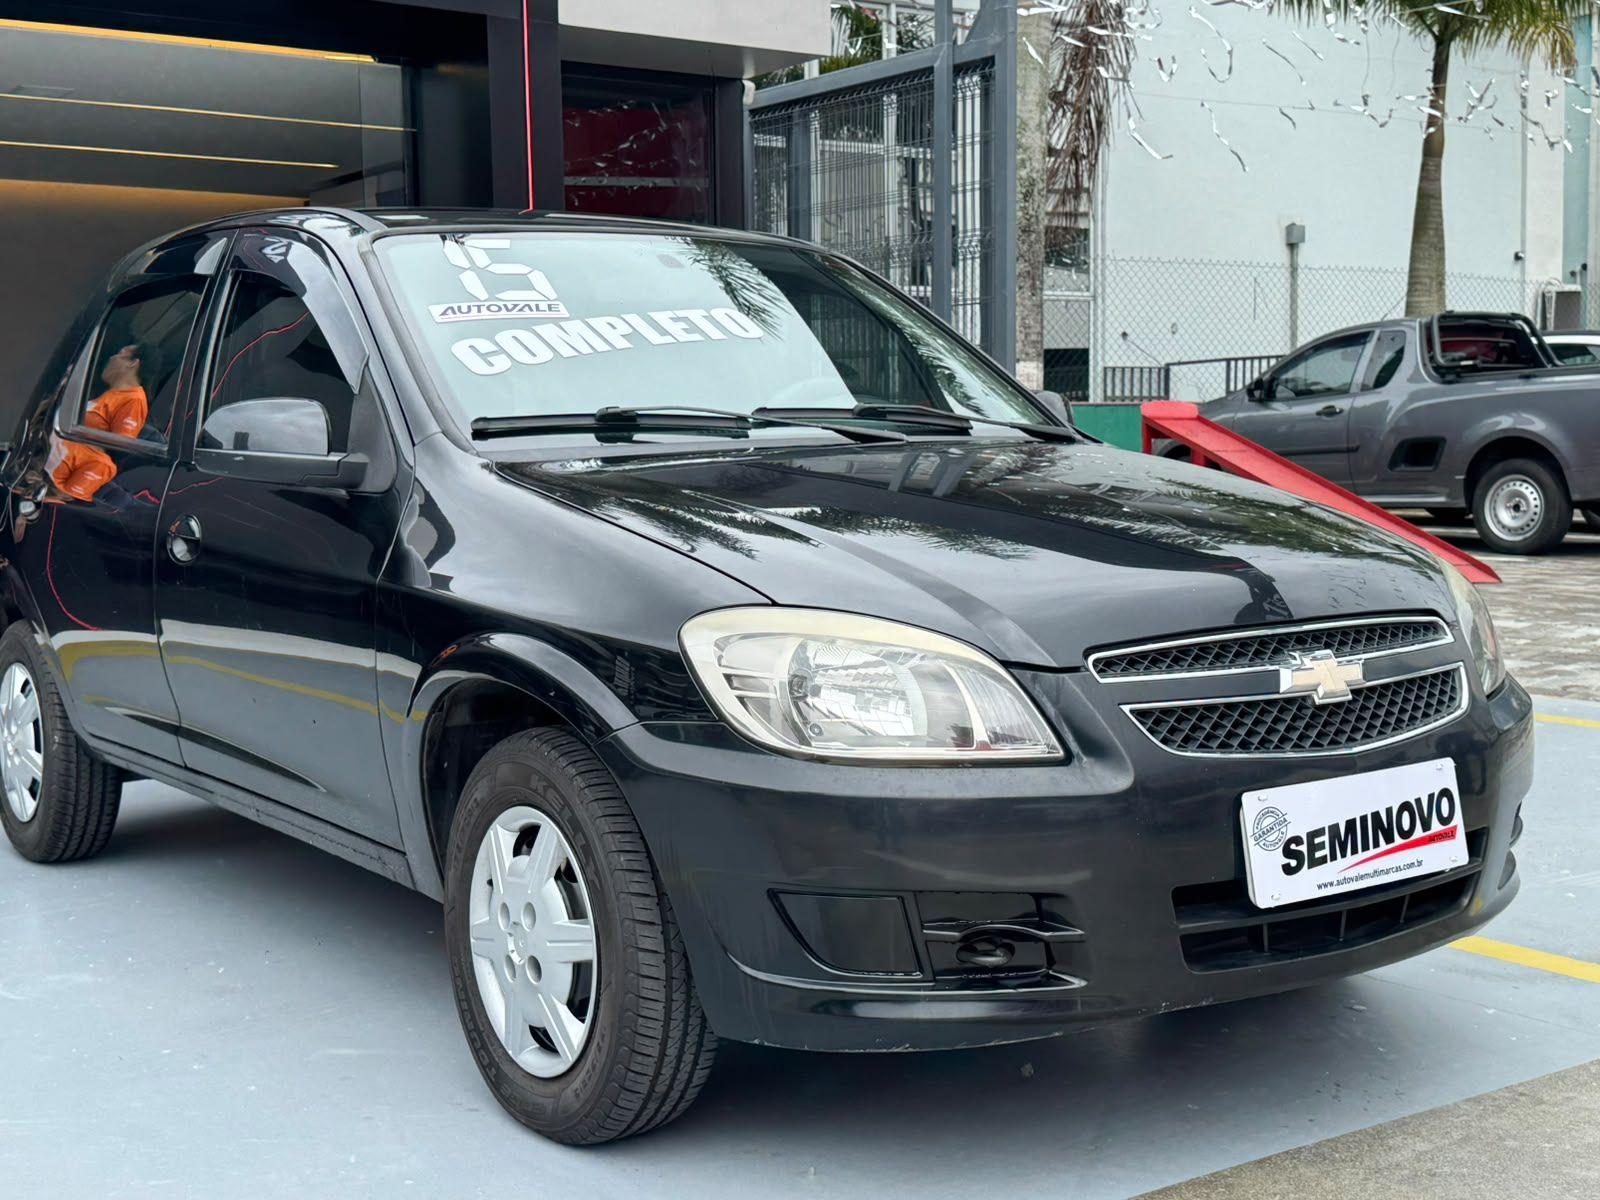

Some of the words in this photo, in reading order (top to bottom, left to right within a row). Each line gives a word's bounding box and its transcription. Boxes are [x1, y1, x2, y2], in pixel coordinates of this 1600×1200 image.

[438, 303, 561, 317] AUTOVALE
[451, 308, 764, 375] COMPLETO
[529, 775, 601, 890] KELLY
[1254, 817, 1288, 841] GARANTIDA
[1281, 787, 1455, 876] SEMINOVO
[1316, 858, 1424, 890] www.autovalemultimarcas.com.br
